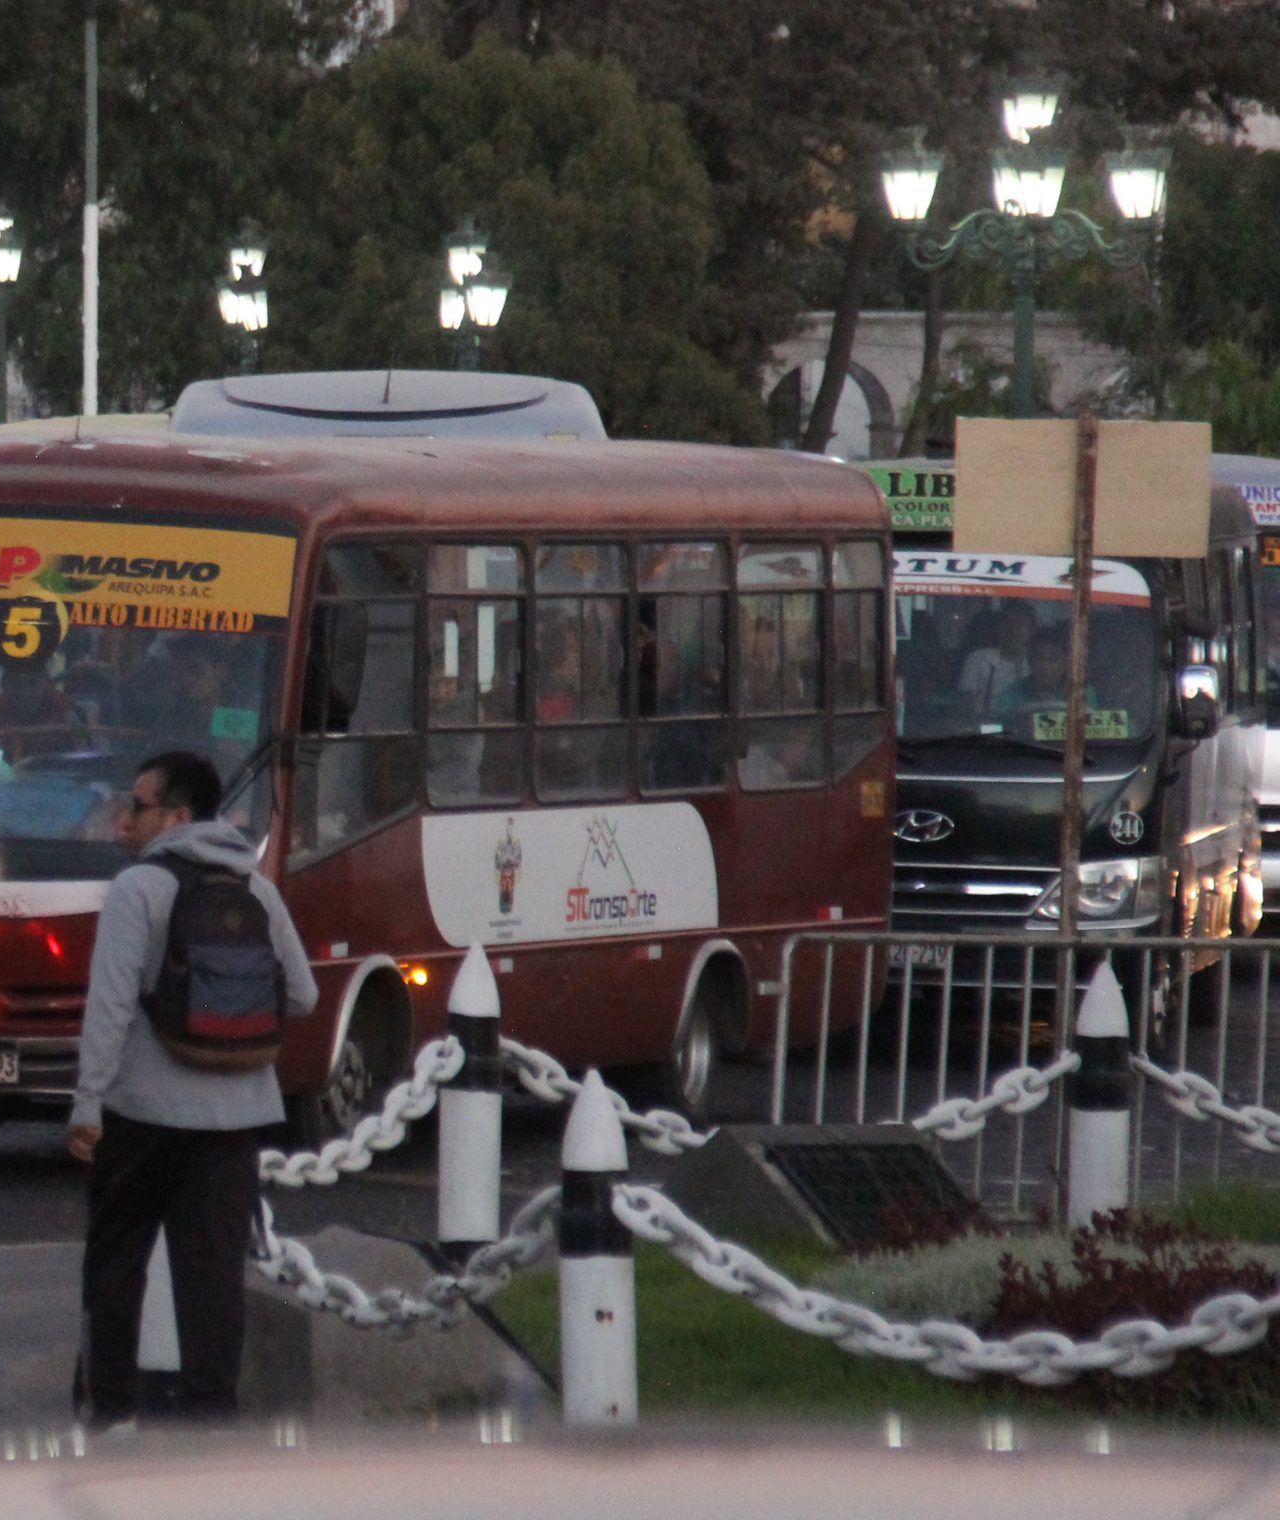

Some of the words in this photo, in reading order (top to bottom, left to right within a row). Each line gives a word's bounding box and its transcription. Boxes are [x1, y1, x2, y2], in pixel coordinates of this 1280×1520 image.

[60, 554, 221, 582] MASIVO
[108, 581, 174, 595] AREQUIPA
[2, 606, 43, 658] 5
[70, 602, 128, 627] ALTO
[136, 605, 255, 633] LIBERTAD
